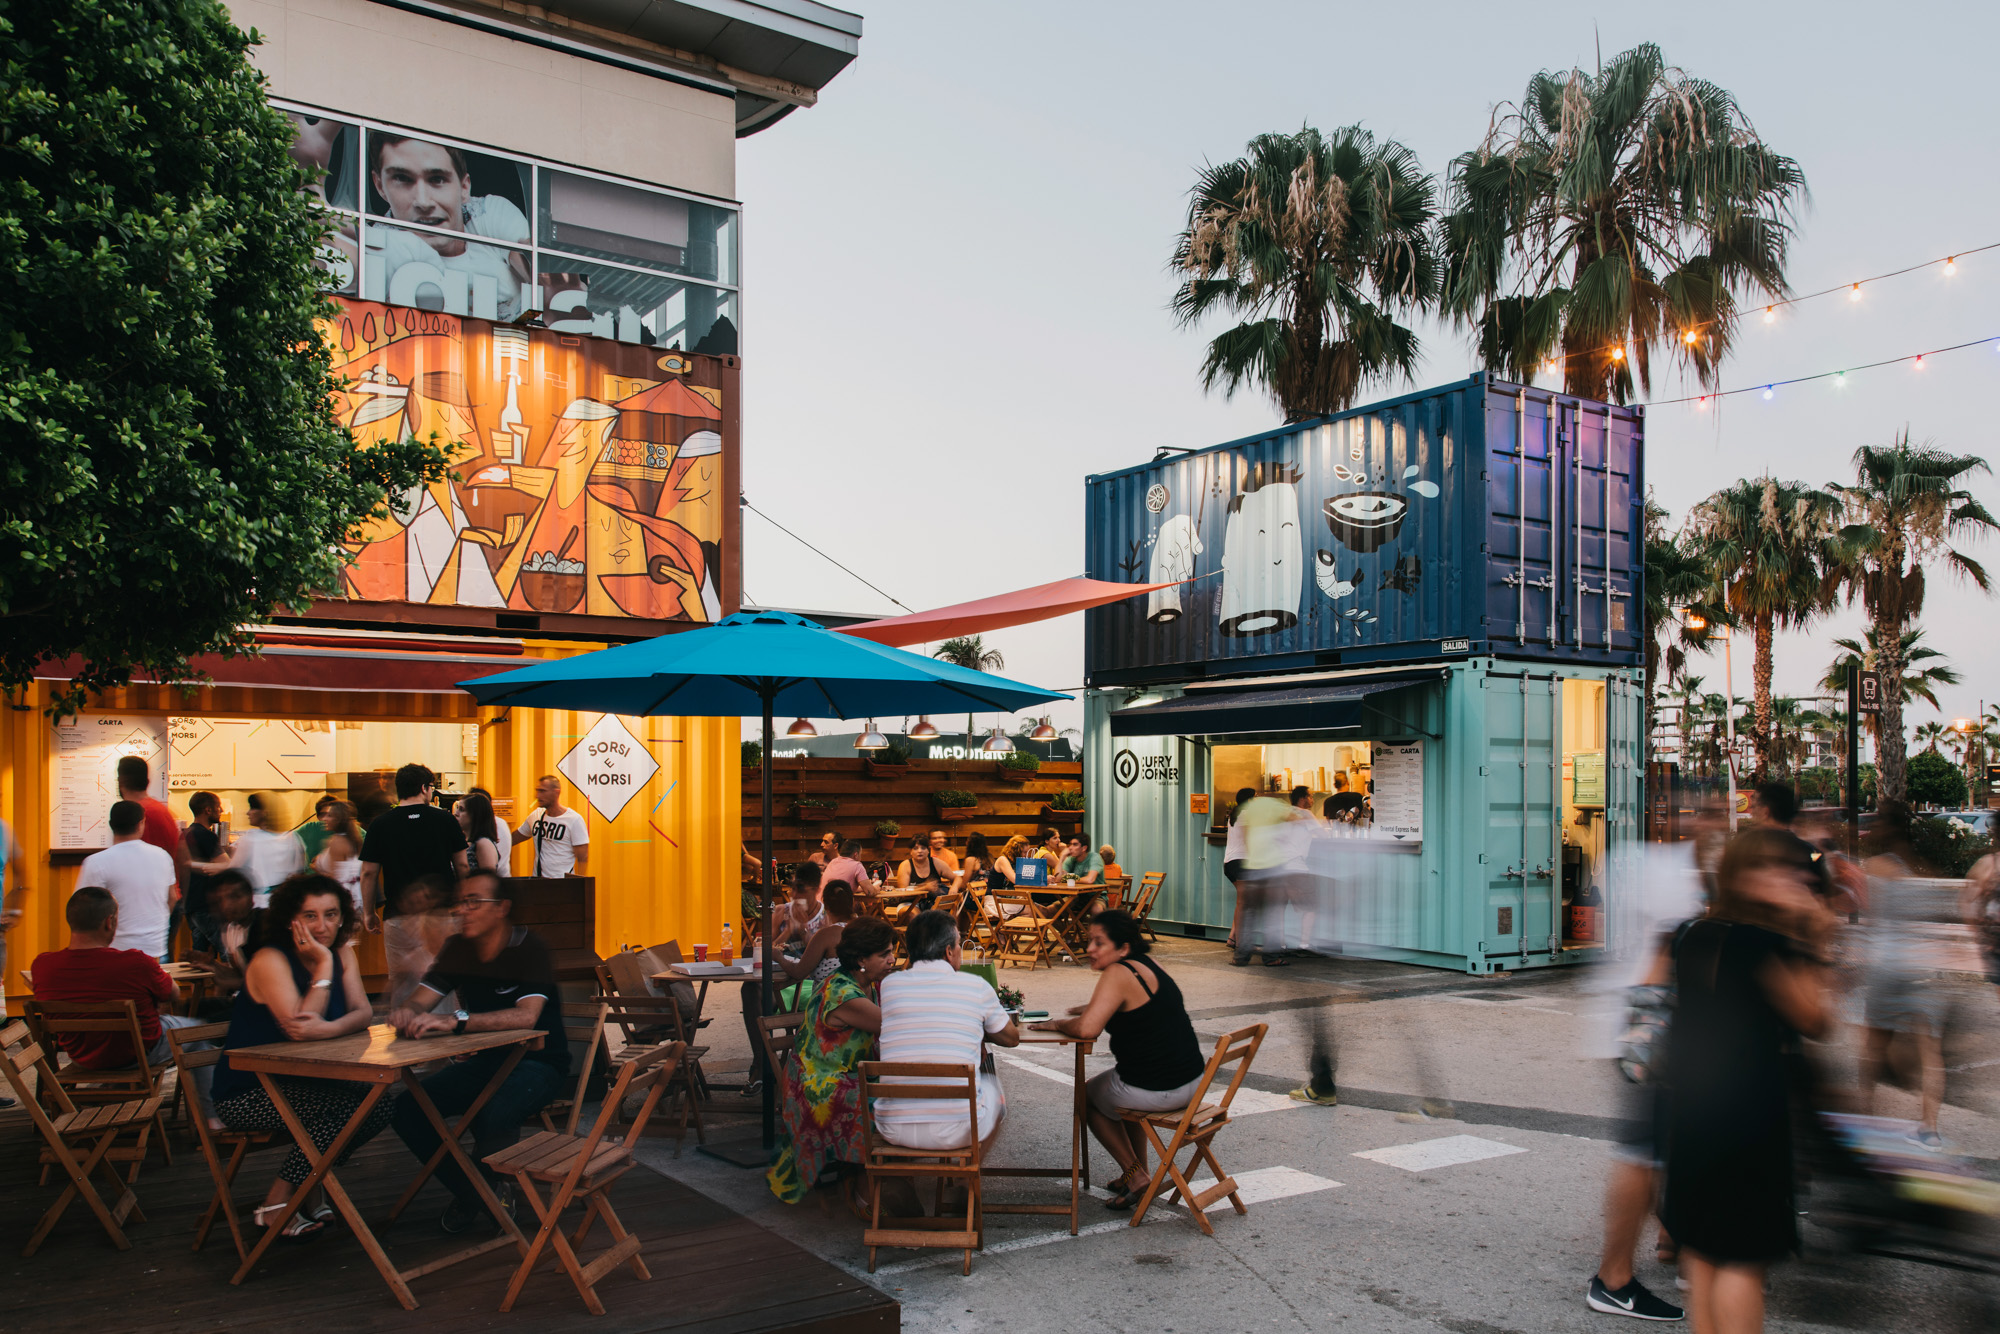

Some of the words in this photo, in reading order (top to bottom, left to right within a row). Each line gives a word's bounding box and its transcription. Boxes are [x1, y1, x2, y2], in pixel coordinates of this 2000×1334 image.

[1443, 641, 1467, 650] SALIDA
[128, 738, 149, 746] SORSI
[588, 741, 631, 758] SORSI
[604, 757, 615, 768] E
[587, 774, 631, 785] MORSI
[1395, 825, 1409, 833] Express
